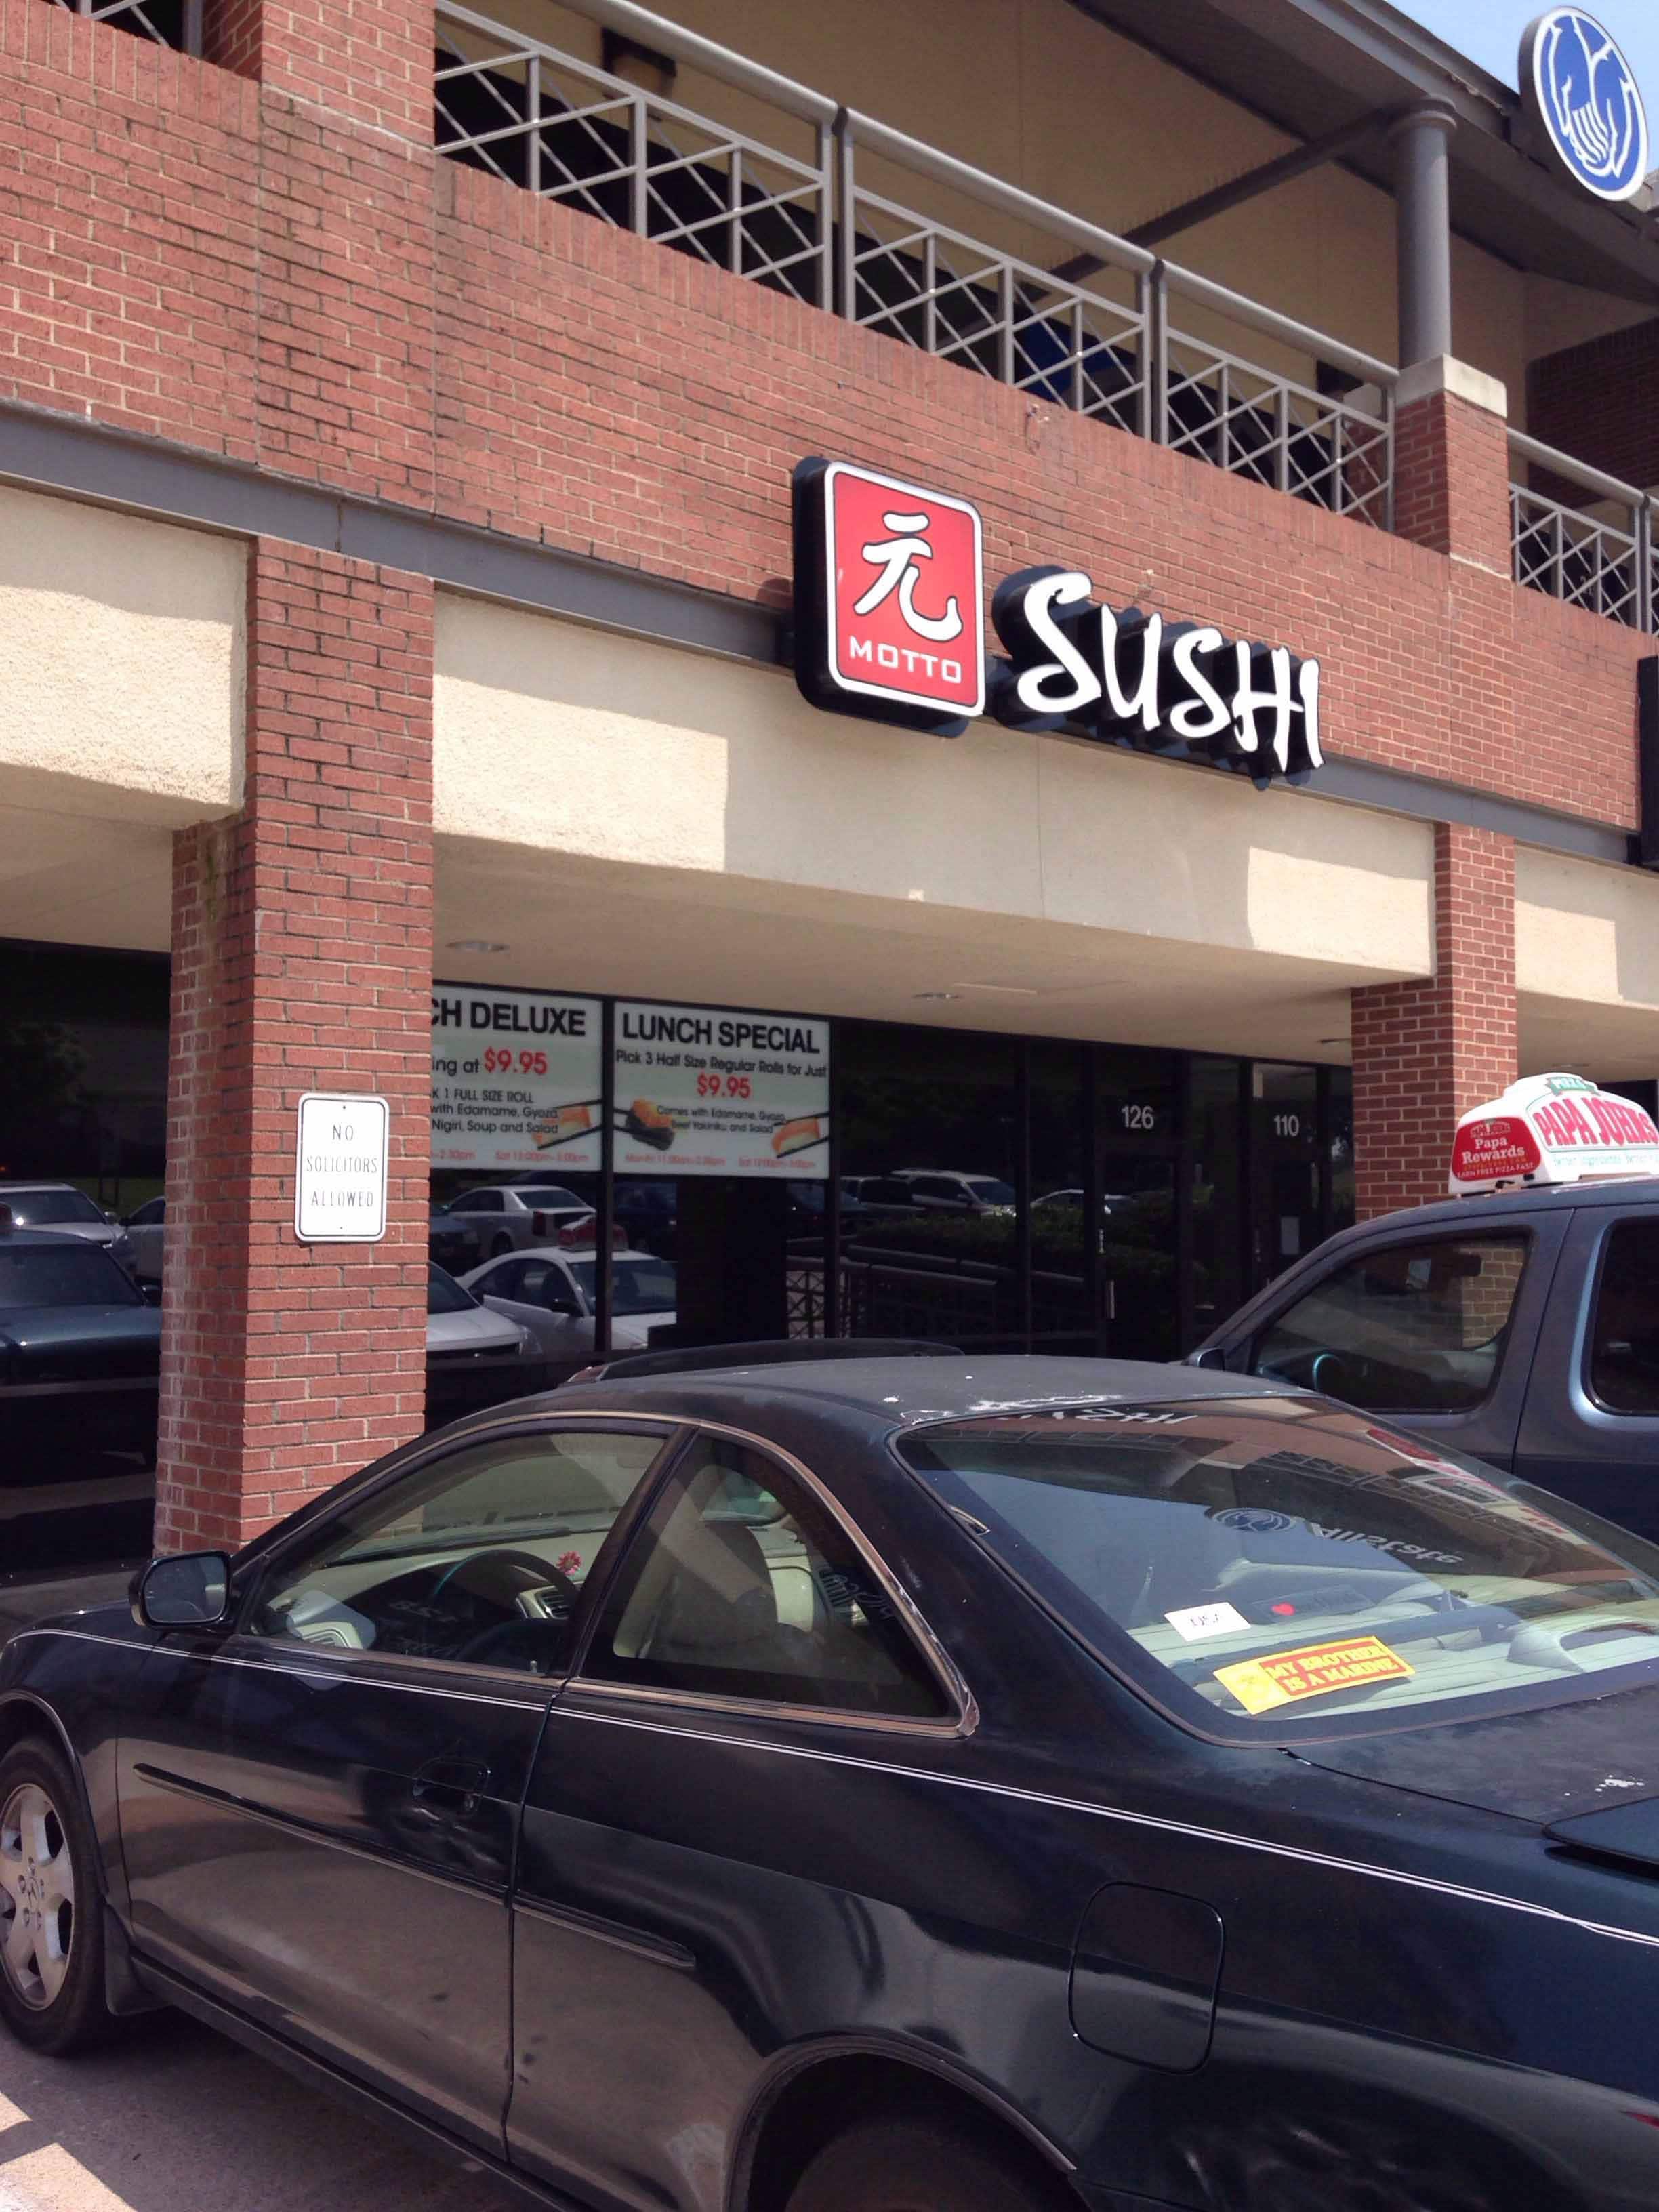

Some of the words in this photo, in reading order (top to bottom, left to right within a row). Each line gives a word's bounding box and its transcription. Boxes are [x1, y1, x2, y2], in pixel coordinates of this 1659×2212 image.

[853, 511, 962, 642] 元
[848, 634, 962, 684] MOTTO
[1017, 571, 1325, 772] SUSHI
[470, 1001, 586, 1037] DELUXE
[623, 1012, 712, 1045] LUNCH
[718, 1021, 820, 1054] SPECIAL
[463, 1058, 479, 1073] at
[484, 1046, 548, 1075] $9.95
[615, 1049, 640, 1064] Pick
[645, 1052, 653, 1065] 3
[656, 1053, 681, 1067] Half
[684, 1054, 707, 1068] Size
[711, 1056, 756, 1073] Regular
[759, 1060, 784, 1075] Rolls
[787, 1062, 802, 1076] for
[804, 1065, 827, 1078] Just
[445, 1088, 449, 1099] 1
[454, 1089, 478, 1101] FULL
[482, 1090, 504, 1103] SIZE
[507, 1091, 534, 1103] ROLL
[697, 1069, 752, 1099] $9.95
[430, 1103, 453, 1115] with
[1121, 1105, 1154, 1130] 126
[332, 1124, 354, 1141] NO
[467, 1120, 497, 1134] Soup
[500, 1122, 523, 1133] and
[527, 1122, 558, 1134] Salad
[1273, 1115, 1300, 1137] 110
[1532, 1098, 1598, 1146] PAPA
[1462, 1145, 1525, 1164] Rewards
[1475, 1137, 1508, 1151] Papa
[306, 1155, 377, 1174] SOLICITORS
[310, 1191, 374, 1207] ALLOWED
[1264, 1662, 1298, 1679] MY
[1283, 1677, 1308, 1692] IS
[1309, 1672, 1326, 1687] A
[1322, 1658, 1399, 1681] MARINE
